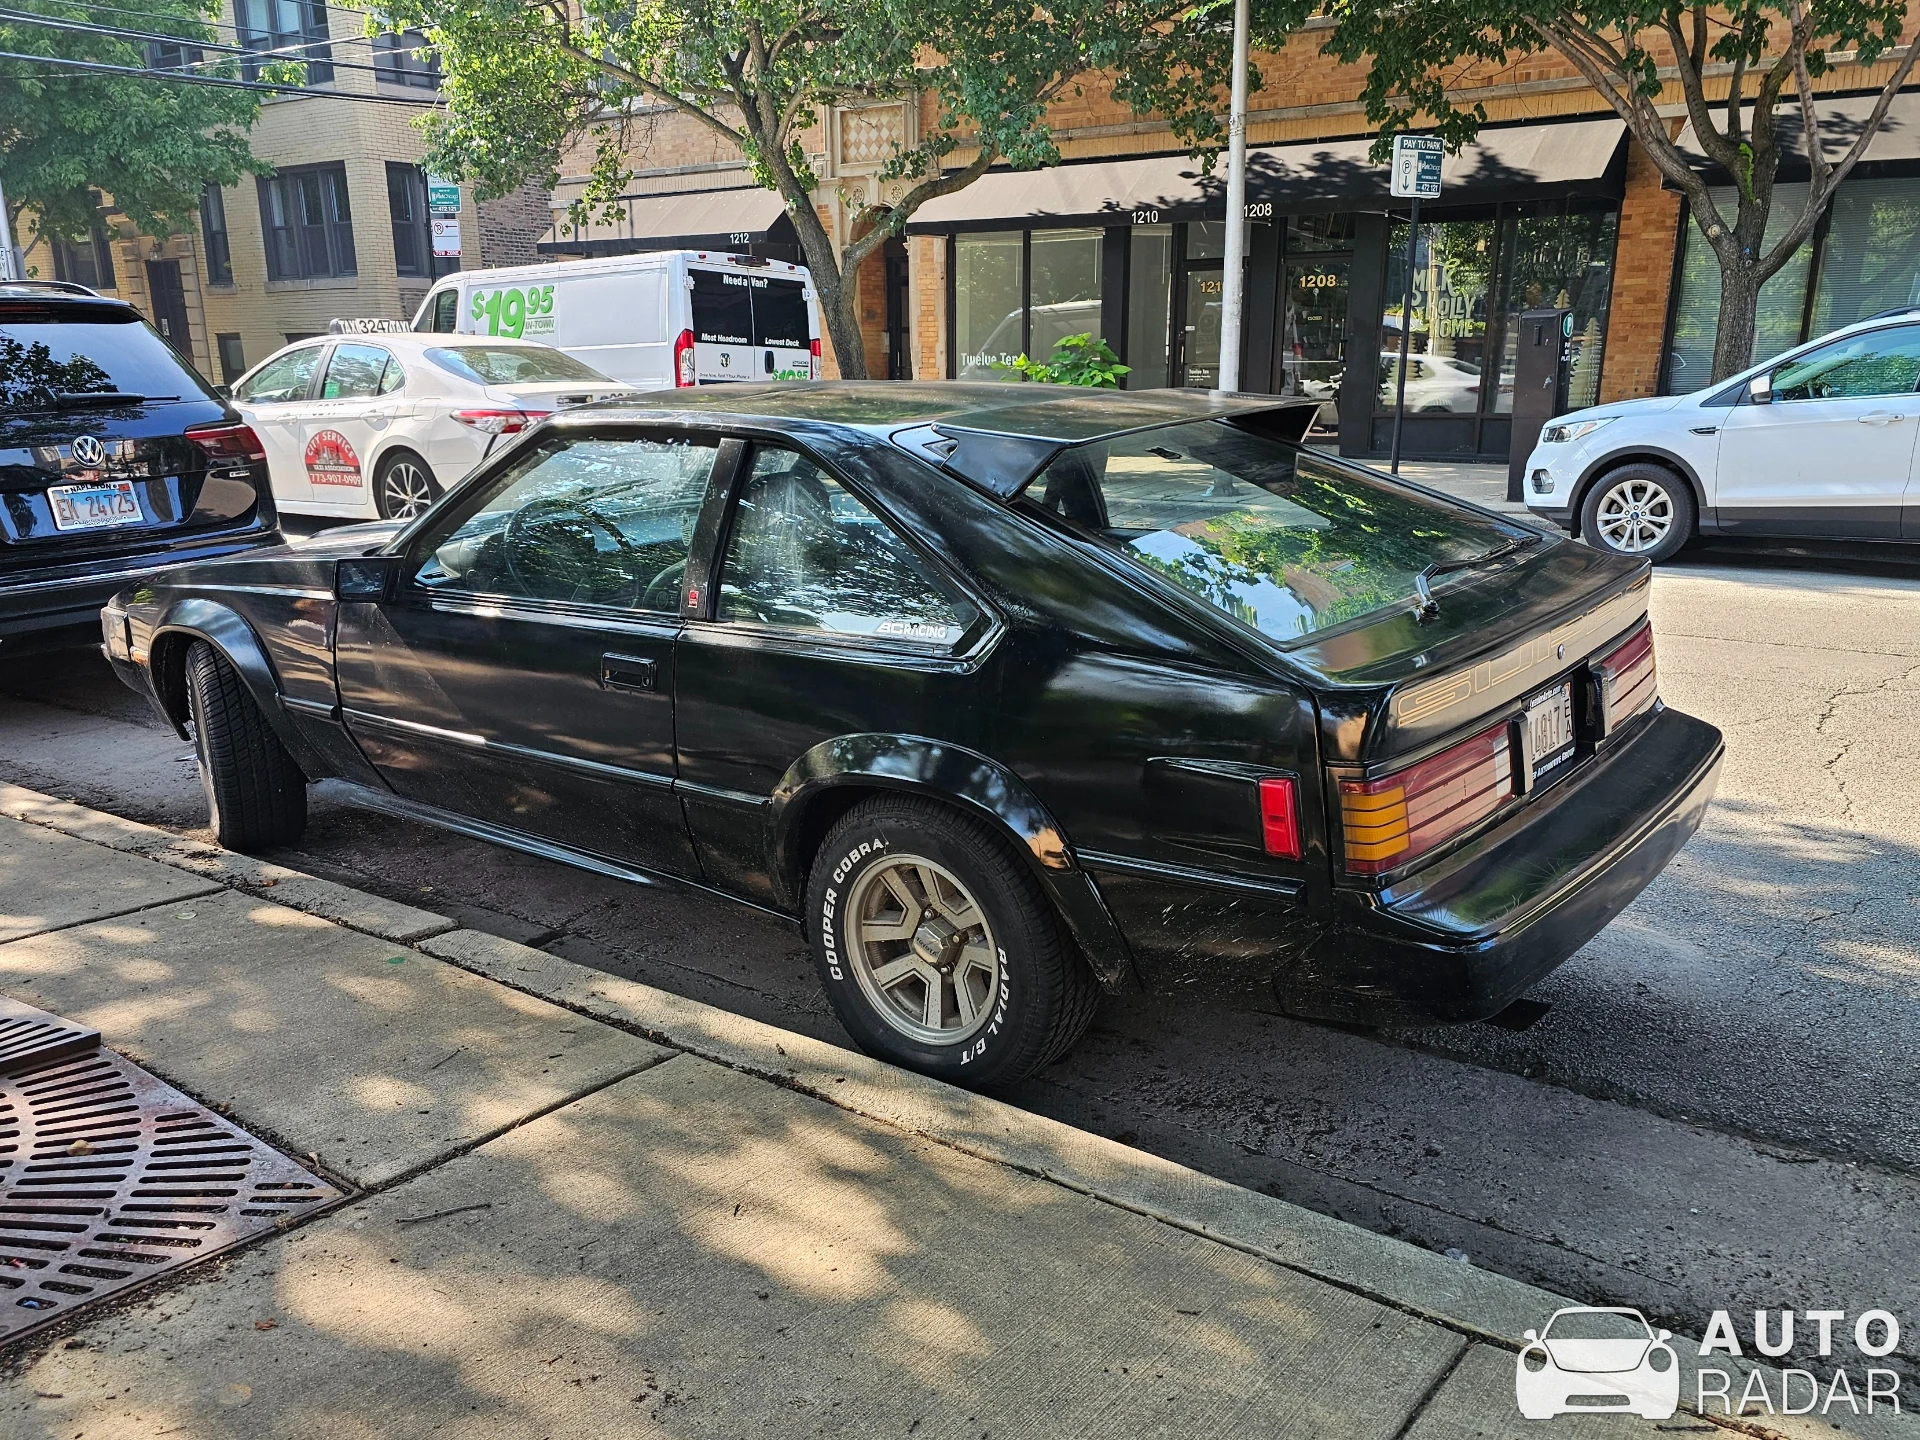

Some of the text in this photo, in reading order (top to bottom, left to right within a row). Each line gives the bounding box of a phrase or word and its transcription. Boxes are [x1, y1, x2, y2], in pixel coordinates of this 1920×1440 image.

[1403, 139, 1441, 150] PAY TO PARK
[1421, 184, 1430, 192] 472
[1430, 184, 1438, 192] 121
[1131, 210, 1159, 224] 1210
[1243, 203, 1273, 218] 1208
[729, 232, 750, 244] 1212
[722, 274, 769, 289] Need a Van?
[1200, 281, 1224, 293] 121
[1299, 274, 1337, 288] 1208
[338, 320, 360, 334] TAXI
[360, 319, 391, 334] 3247
[525, 319, 555, 330] IN-TOWN
[701, 333, 748, 344] Most Headroom
[764, 337, 800, 347] Lowest Deck
[306, 430, 355, 458] CITY SERVICE
[310, 473, 361, 485] 773-907-0909
[70, 483, 112, 493] NAPLETON
[56, 498, 79, 520] EK
[86, 492, 136, 517] 24725
[822, 838, 882, 981] COOPER COBRA
[960, 946, 1010, 1066] RADIAL G/T
